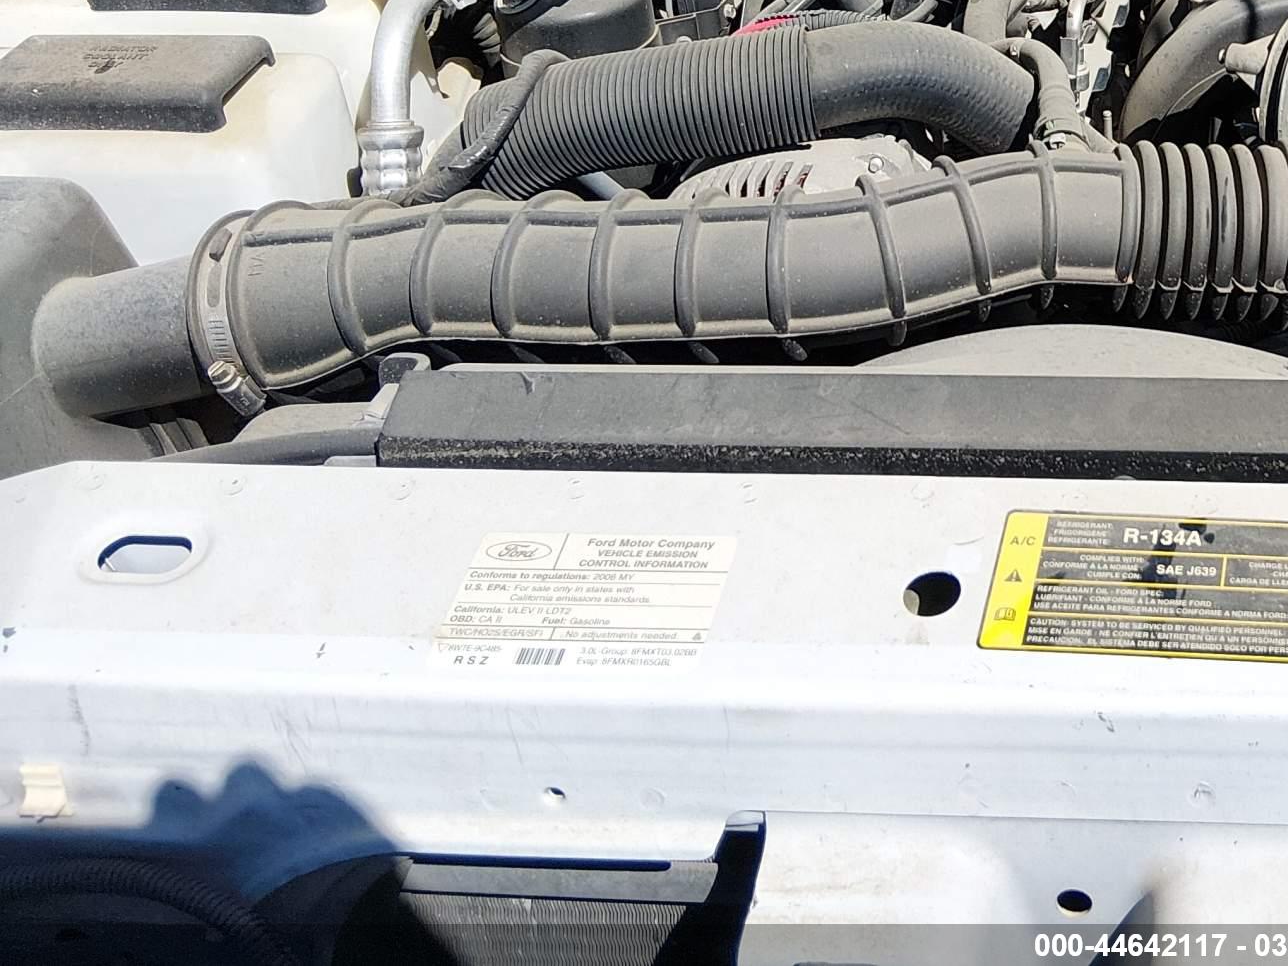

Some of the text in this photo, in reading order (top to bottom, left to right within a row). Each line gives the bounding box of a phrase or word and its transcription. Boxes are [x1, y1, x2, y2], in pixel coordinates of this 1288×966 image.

[1010, 536, 1036, 546] A/C
[1123, 527, 1202, 547] R-134A
[587, 538, 715, 550] Ford Motor Company
[498, 544, 538, 558] Ford
[598, 549, 698, 559] VEHICLE EMISSION
[578, 559, 709, 569] CONTROL INFORMATION
[1080, 554, 1121, 563] COMPLIES
[1042, 560, 1088, 570] CONFORME
[1156, 563, 1217, 577] SAE J639
[1249, 561, 1283, 570] CHARGE
[469, 571, 518, 579] Conforms
[520, 571, 530, 580] to
[532, 572, 591, 582] regulations:
[1087, 571, 1120, 579] CUMPLE
[1229, 577, 1258, 585] CARGA
[464, 583, 483, 591] U.S.
[487, 584, 511, 592] EPA:
[553, 585, 573, 594] only
[585, 586, 613, 594] states
[615, 586, 635, 594] with
[1037, 584, 1094, 594] REFRIGERANT
[1095, 586, 1109, 595] OIL
[1116, 588, 1139, 596] FORD
[510, 593, 552, 602] California
[1035, 593, 1083, 603] LUBRIFIANT
[1089, 595, 1136, 605] CONFORME
[1157, 599, 1188, 607] NORME
[453, 605, 505, 614] California:
[507, 606, 535, 614] ULEV
[1033, 602, 1288, 620] USE ACEITE PARA REFRIGERANTES CONFORME NORMA FORD:
[450, 615, 611, 626] OBD: CA Fuel: Gasoline
[1071, 619, 1105, 628] SYSTEM
[1132, 622, 1174, 631] SERVICED
[1188, 624, 1232, 633] QUALIFIED
[1028, 626, 1049, 635] MISE
[1063, 628, 1093, 637] GARDE
[1112, 631, 1149, 639] CONFIER
[1100, 638, 1136, 648] SISTEMA
[1137, 640, 1161, 648] DEBE
[1162, 641, 1179, 649] SER
[1180, 642, 1223, 652] ATENDIDO
[1224, 643, 1247, 652] SOLO
[1248, 645, 1267, 654] POR
[453, 655, 490, 665] R S Z
